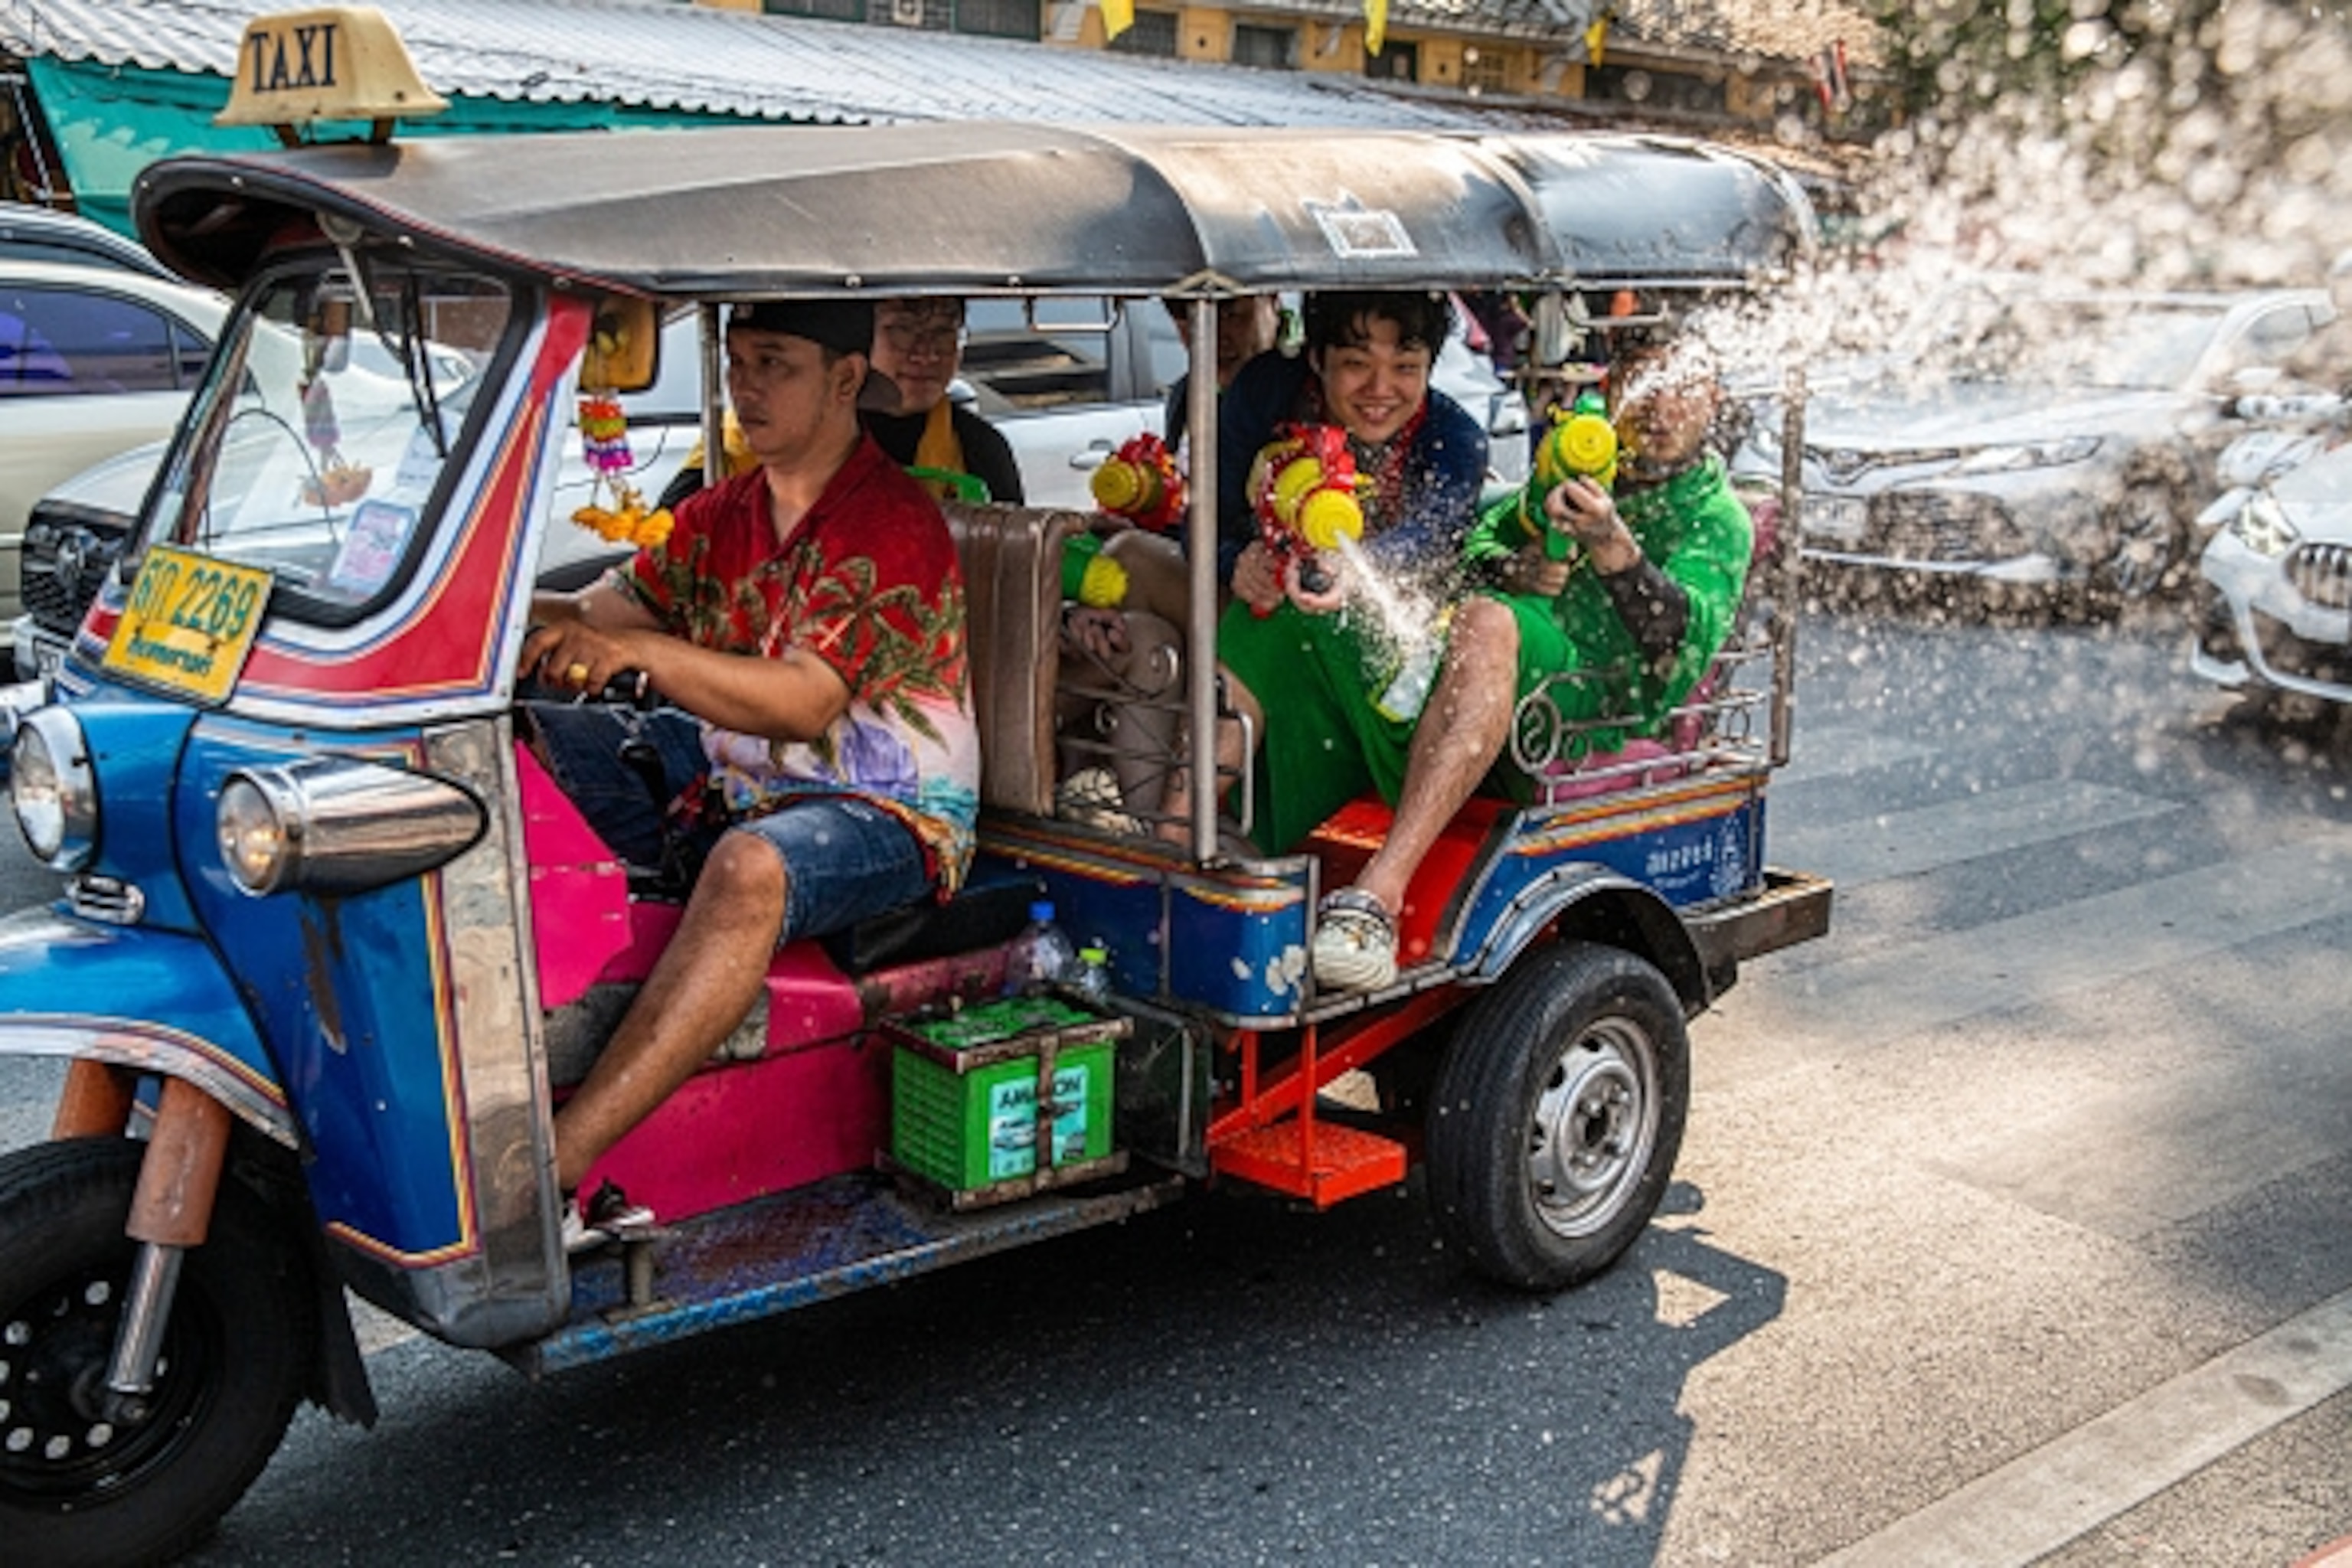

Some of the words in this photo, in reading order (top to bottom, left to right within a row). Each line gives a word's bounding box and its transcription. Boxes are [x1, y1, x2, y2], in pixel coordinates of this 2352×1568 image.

[250, 24, 337, 93] TAXI
[172, 568, 257, 638] 2269
[998, 1074, 1081, 1109] AMON
